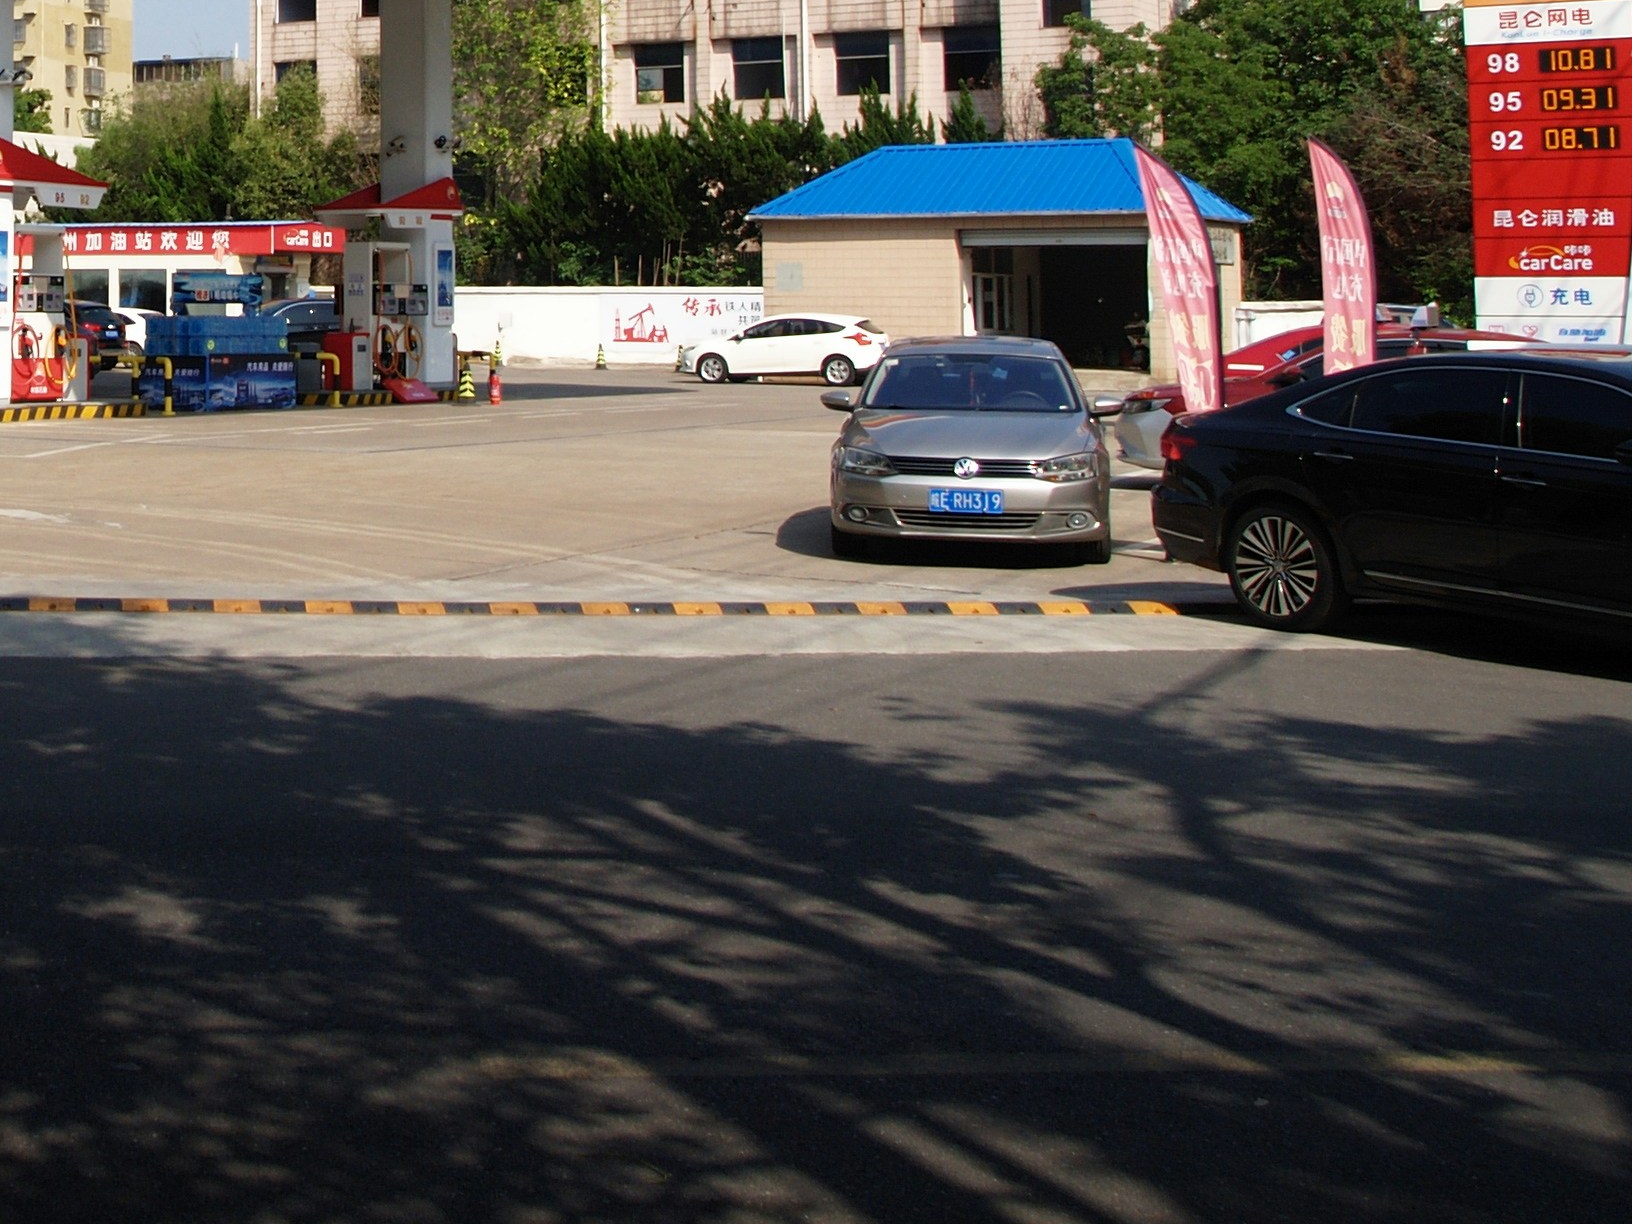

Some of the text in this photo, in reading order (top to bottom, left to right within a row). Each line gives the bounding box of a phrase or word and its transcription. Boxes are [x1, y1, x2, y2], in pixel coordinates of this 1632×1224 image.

[1499, 8, 1593, 29] 昆仑网电
[1487, 48, 1611, 73] 98 10.81
[1489, 87, 1613, 112] 95 09.31
[1491, 127, 1615, 150] 92 08.71
[1493, 208, 1615, 227] 昆仑润滑油
[312, 230, 333, 248] 出口
[1519, 255, 1593, 271] carCare
[682, 296, 722, 317] 传承
[1550, 288, 1593, 306] 充电
